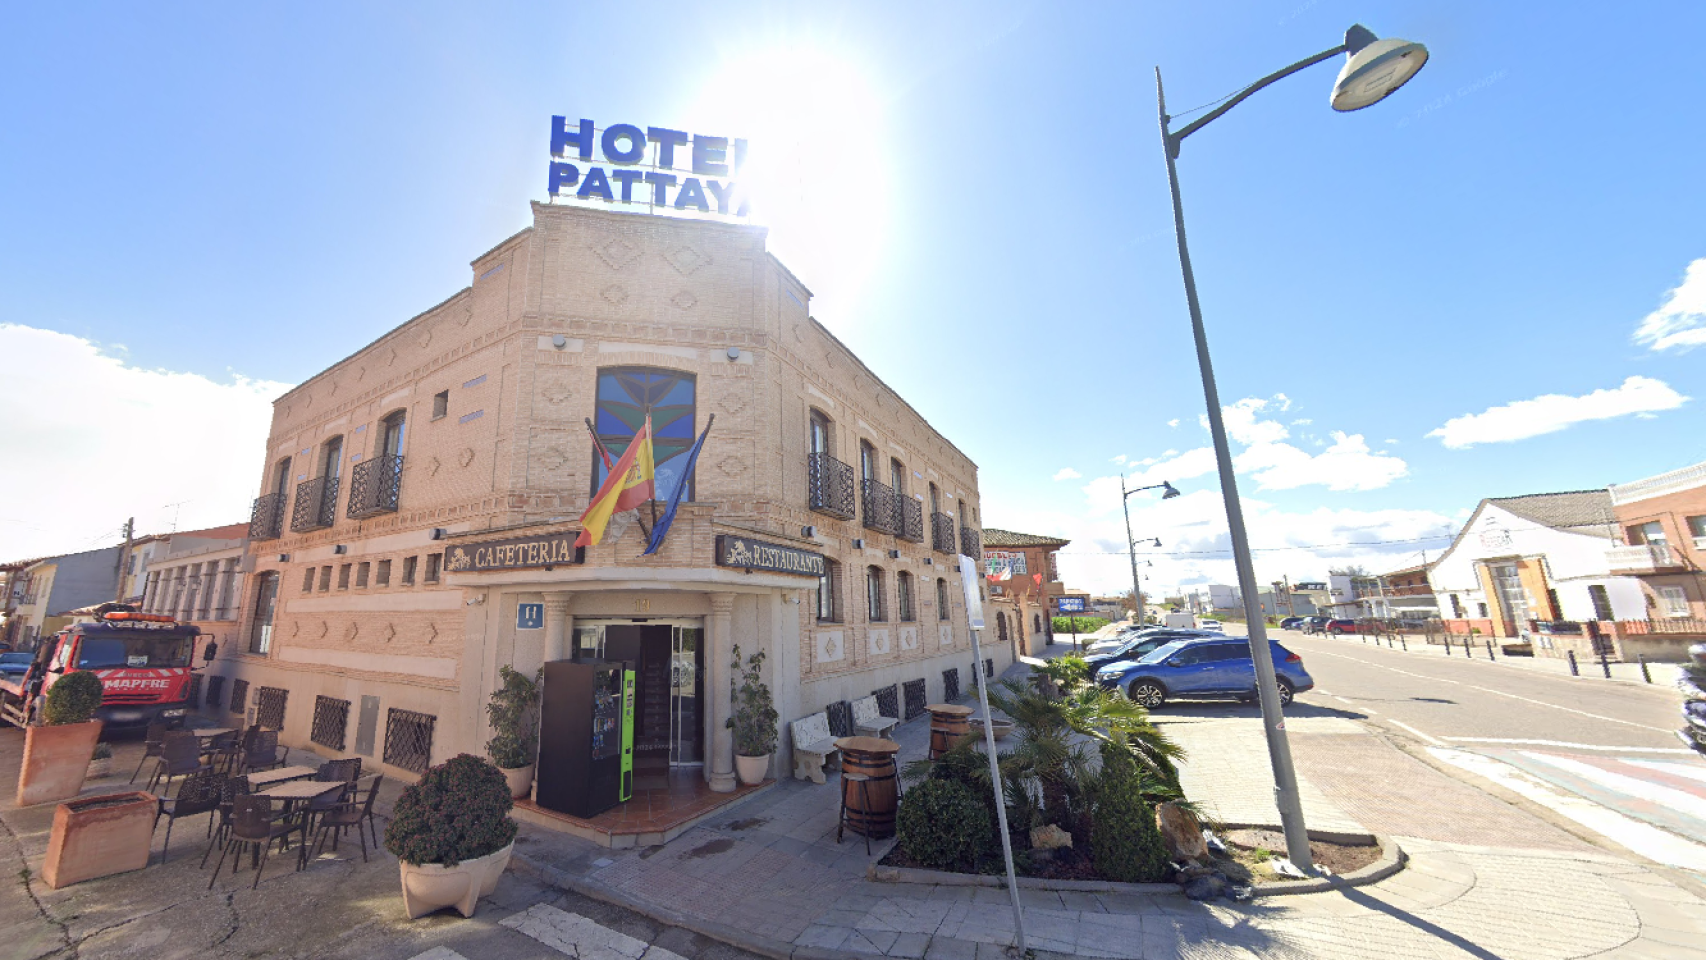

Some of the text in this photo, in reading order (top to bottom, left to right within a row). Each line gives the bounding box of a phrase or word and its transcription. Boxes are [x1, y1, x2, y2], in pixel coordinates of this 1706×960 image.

[474, 539, 570, 568] CAFETERIA
[752, 544, 825, 575] RESTAURANTE
[634, 598, 651, 612] 19
[104, 679, 171, 689] MAPFRE
